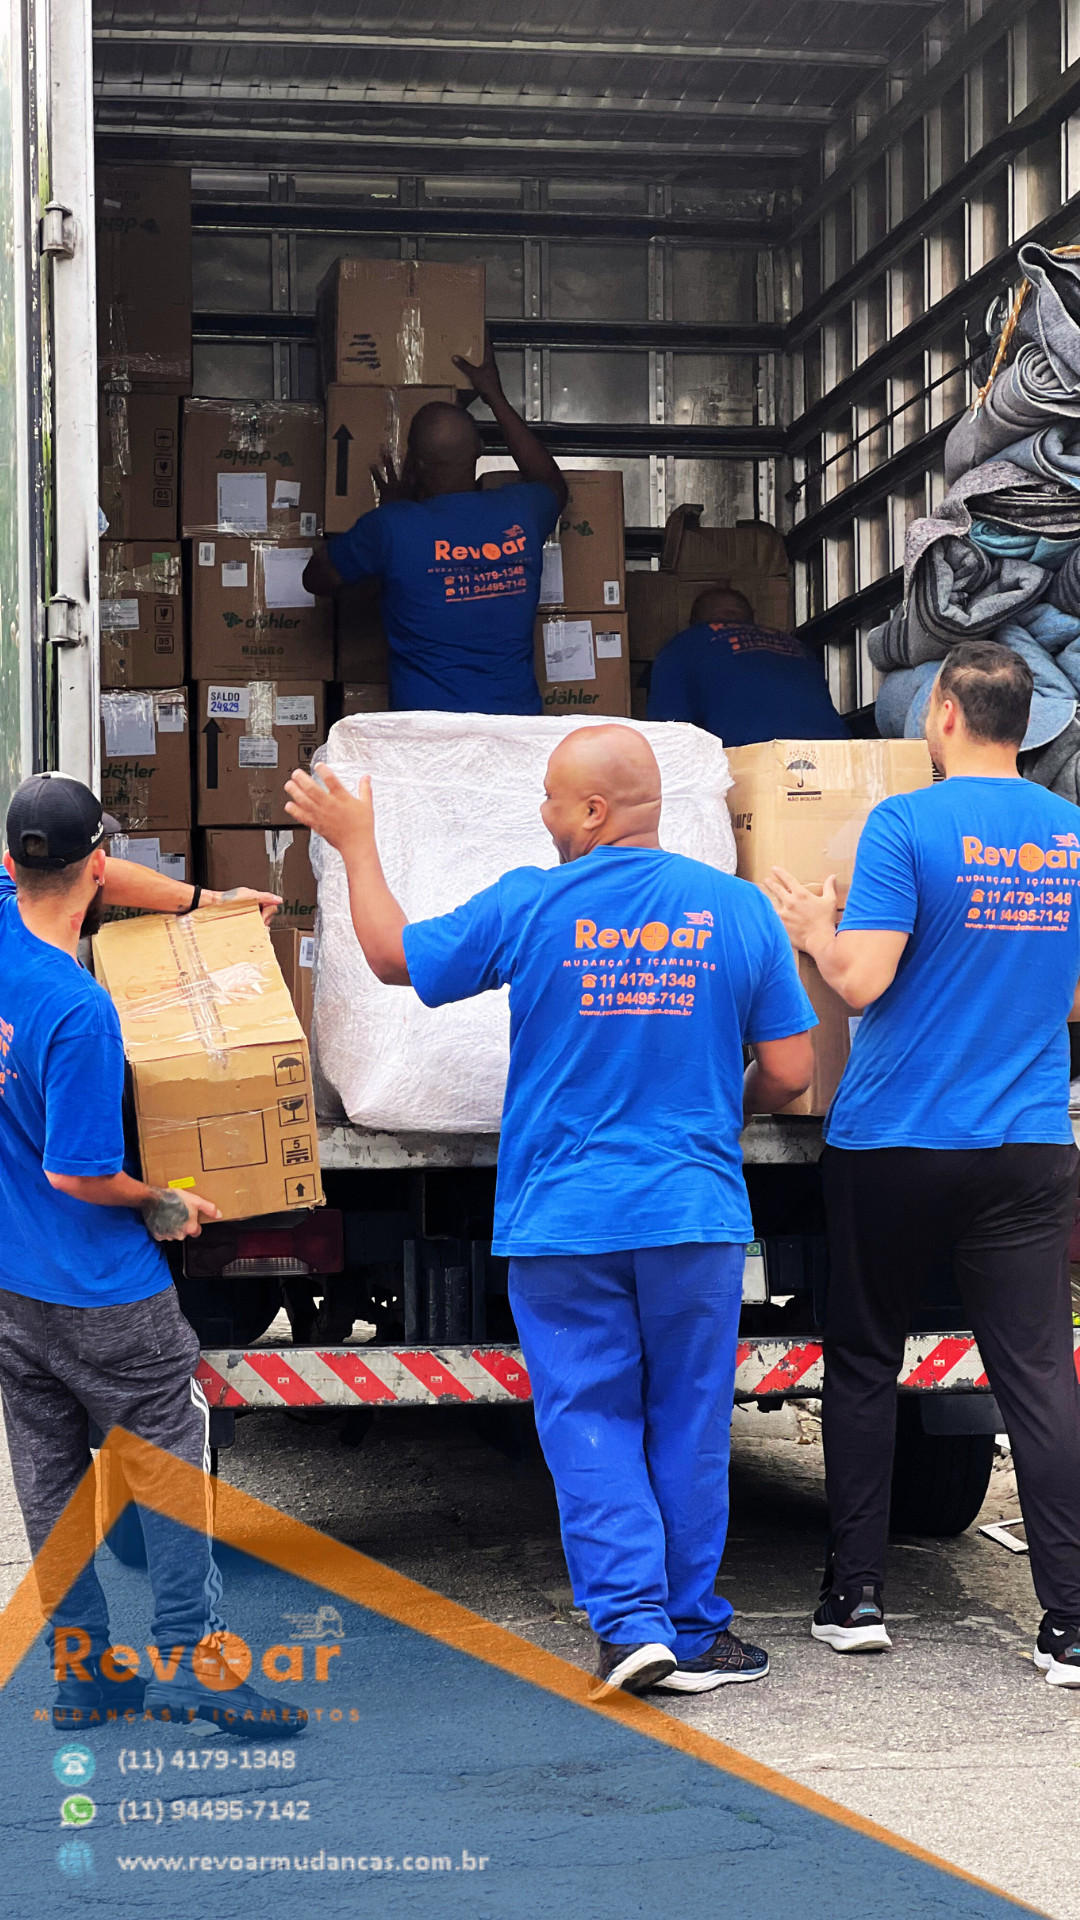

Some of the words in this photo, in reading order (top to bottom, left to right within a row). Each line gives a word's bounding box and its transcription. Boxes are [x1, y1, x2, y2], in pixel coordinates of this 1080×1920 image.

[216, 449, 272, 466] döhler
[157, 491, 169, 499] 05
[457, 574, 470, 583] 11
[474, 565, 525, 582] 4179-1348
[458, 586, 470, 595] 11
[158, 637, 170, 645] 05
[210, 692, 240, 701] SALDO
[545, 688, 600, 704] döhler
[1015, 877, 1020, 885] E
[987, 890, 1001, 904] 11
[1003, 890, 1072, 906] 4179-1348
[277, 899, 317, 916] hler
[984, 908, 997, 921] 11
[635, 957, 641, 966] E
[648, 957, 716, 971] IÇAMENTOS
[599, 974, 616, 988] 11
[619, 972, 696, 989] 4179-1348
[598, 993, 613, 1006] 11
[616, 991, 695, 1008] 94495-7142
[293, 1139, 301, 1150] 5
